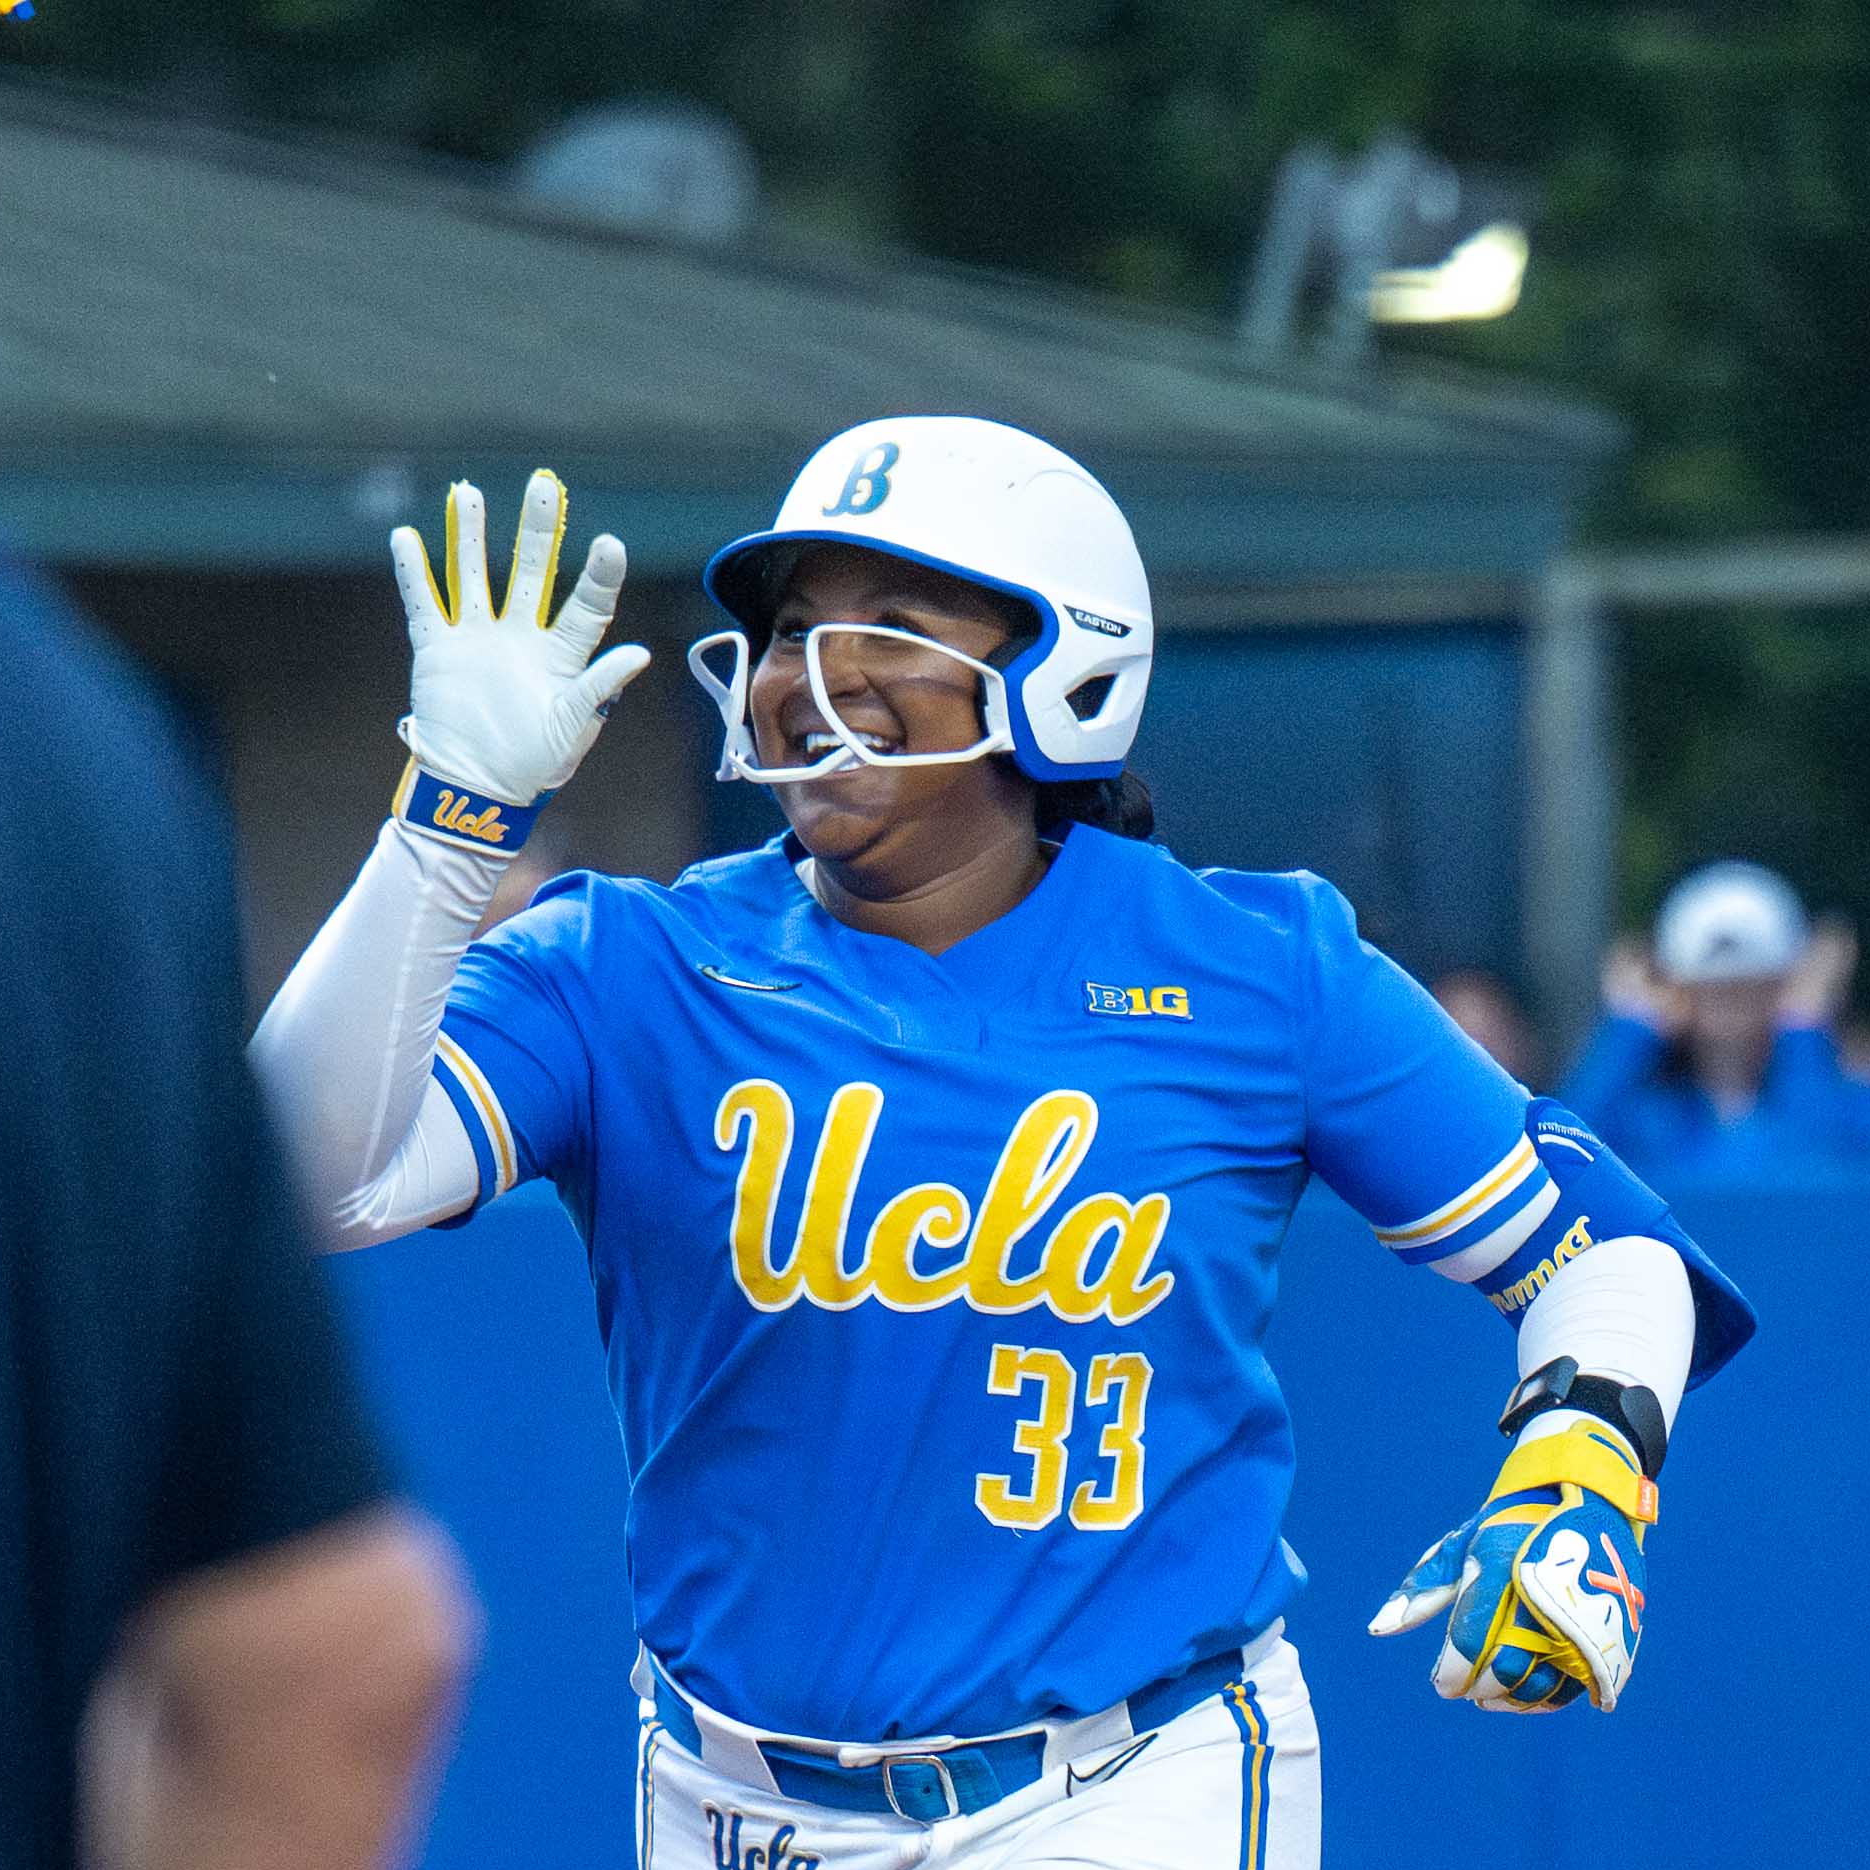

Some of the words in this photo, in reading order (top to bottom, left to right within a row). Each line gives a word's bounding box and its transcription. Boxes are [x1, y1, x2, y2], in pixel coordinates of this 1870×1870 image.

[1075, 610, 1122, 635] EASTON
[433, 789, 510, 843] Ucla
[714, 1078, 1176, 1327] Ucla
[974, 1343, 1155, 1532] 33
